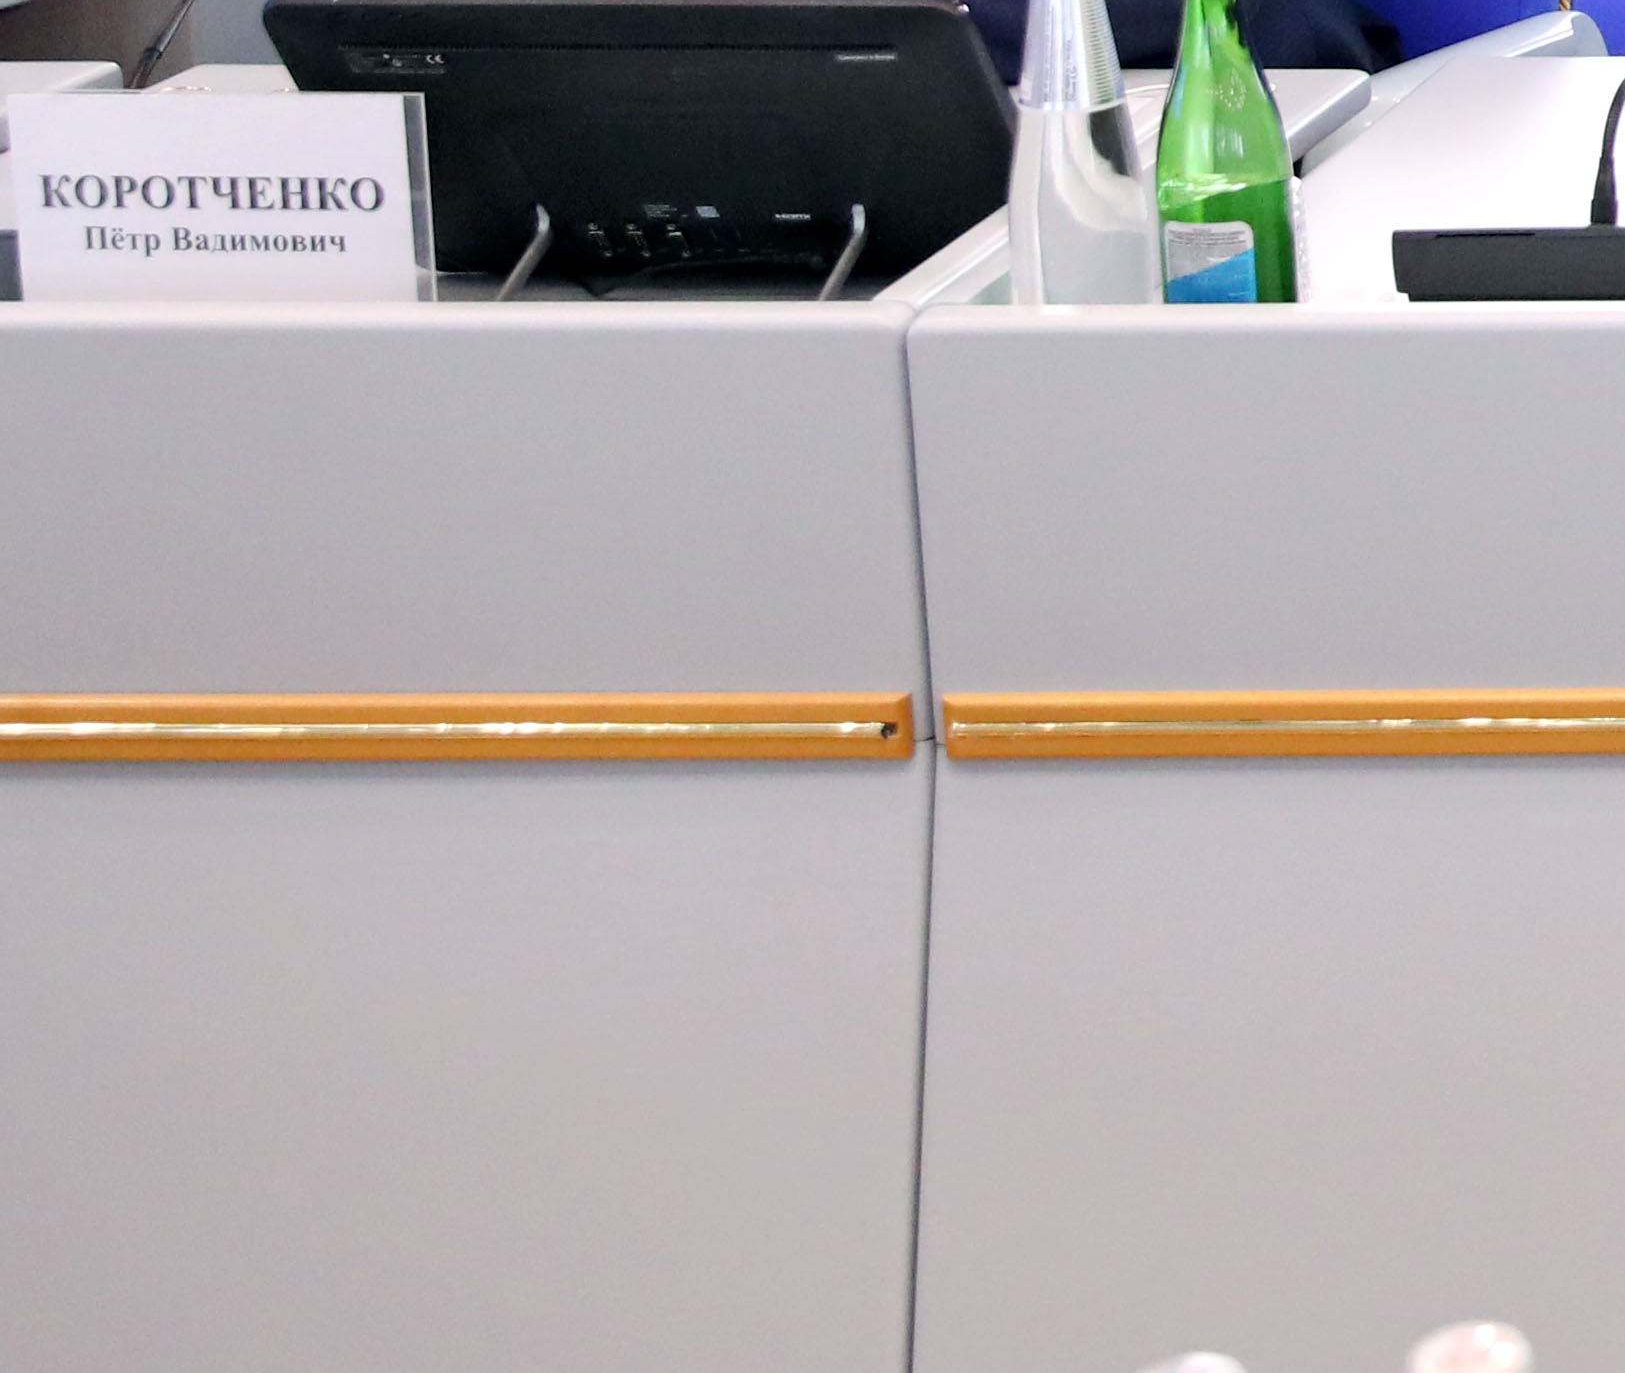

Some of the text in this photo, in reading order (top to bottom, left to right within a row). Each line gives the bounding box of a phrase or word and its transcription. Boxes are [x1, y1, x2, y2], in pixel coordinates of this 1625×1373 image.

[39, 173, 386, 212] КОРОТЧЕНКО
[84, 225, 346, 257] Пётр Вадимович
